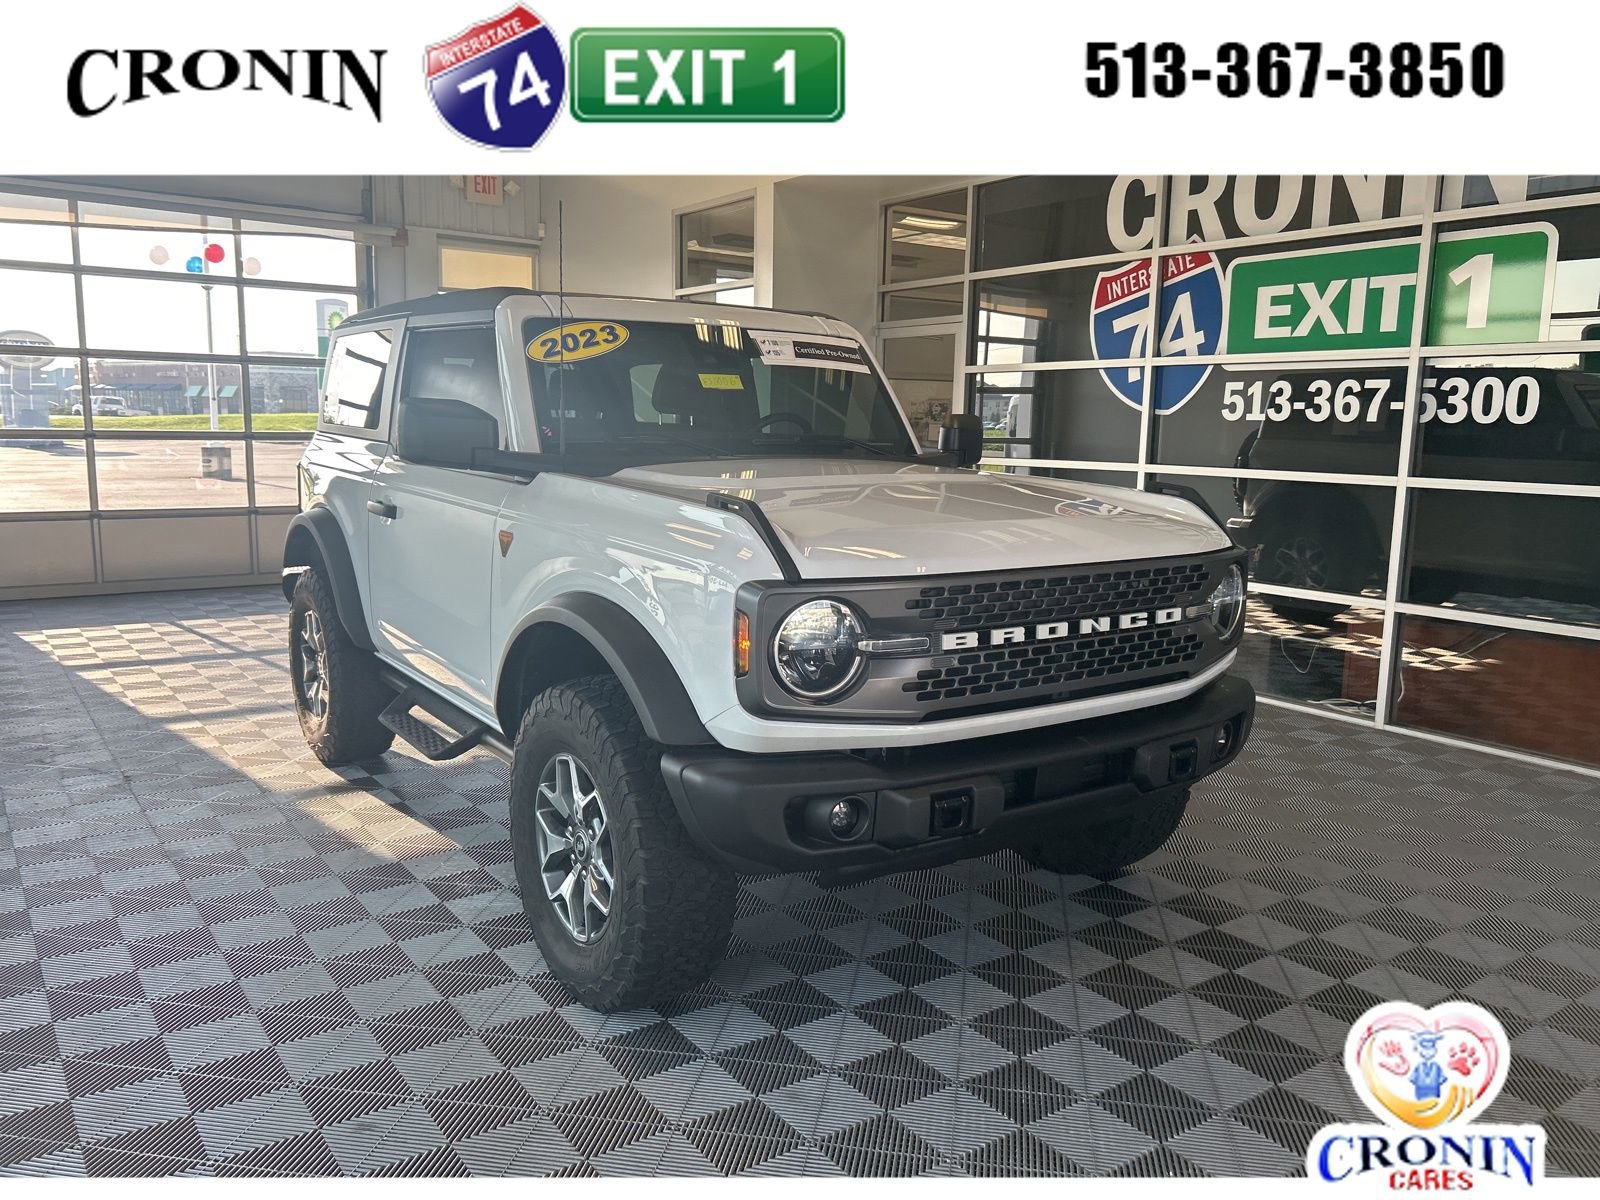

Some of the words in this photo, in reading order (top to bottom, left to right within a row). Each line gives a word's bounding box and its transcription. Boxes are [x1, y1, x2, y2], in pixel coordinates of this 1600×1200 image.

[473, 175, 497, 195] EXIT
[1106, 175, 1528, 251] CRON
[1106, 254, 1196, 301] INTERATE
[1254, 272, 1417, 339] EXIT
[1448, 253, 1494, 329] 1
[540, 325, 620, 359] 2023
[795, 345, 825, 356] Certified
[826, 348, 861, 360] Pre-Owned
[1112, 291, 1205, 383] 74
[1221, 376, 1541, 424] 513-367-5300
[942, 607, 1182, 651] BRONCO
